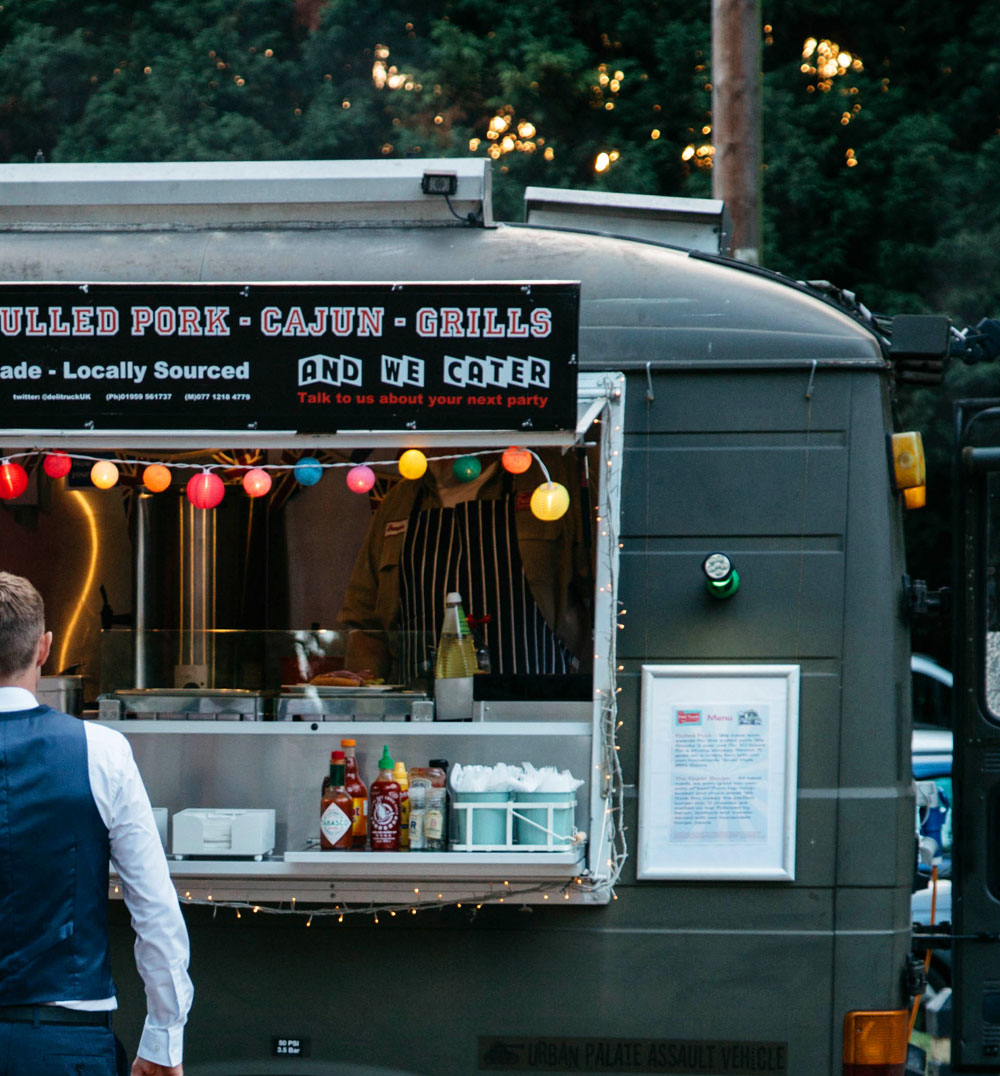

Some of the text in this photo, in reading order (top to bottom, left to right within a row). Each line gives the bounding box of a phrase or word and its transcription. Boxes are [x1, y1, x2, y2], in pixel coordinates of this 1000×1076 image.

[131, 307, 230, 336] PORK
[261, 306, 384, 336] CAJUN
[416, 307, 552, 338] GRILLS
[63, 361, 147, 383] Locally
[153, 361, 250, 380] Sourced
[298, 354, 550, 388] AND WE CATER
[298, 392, 548, 408] Talk to us about your next party
[707, 714, 733, 722] Menu
[528, 1042, 786, 1072] URBAN PALATE ASSAULT VEHICLE
